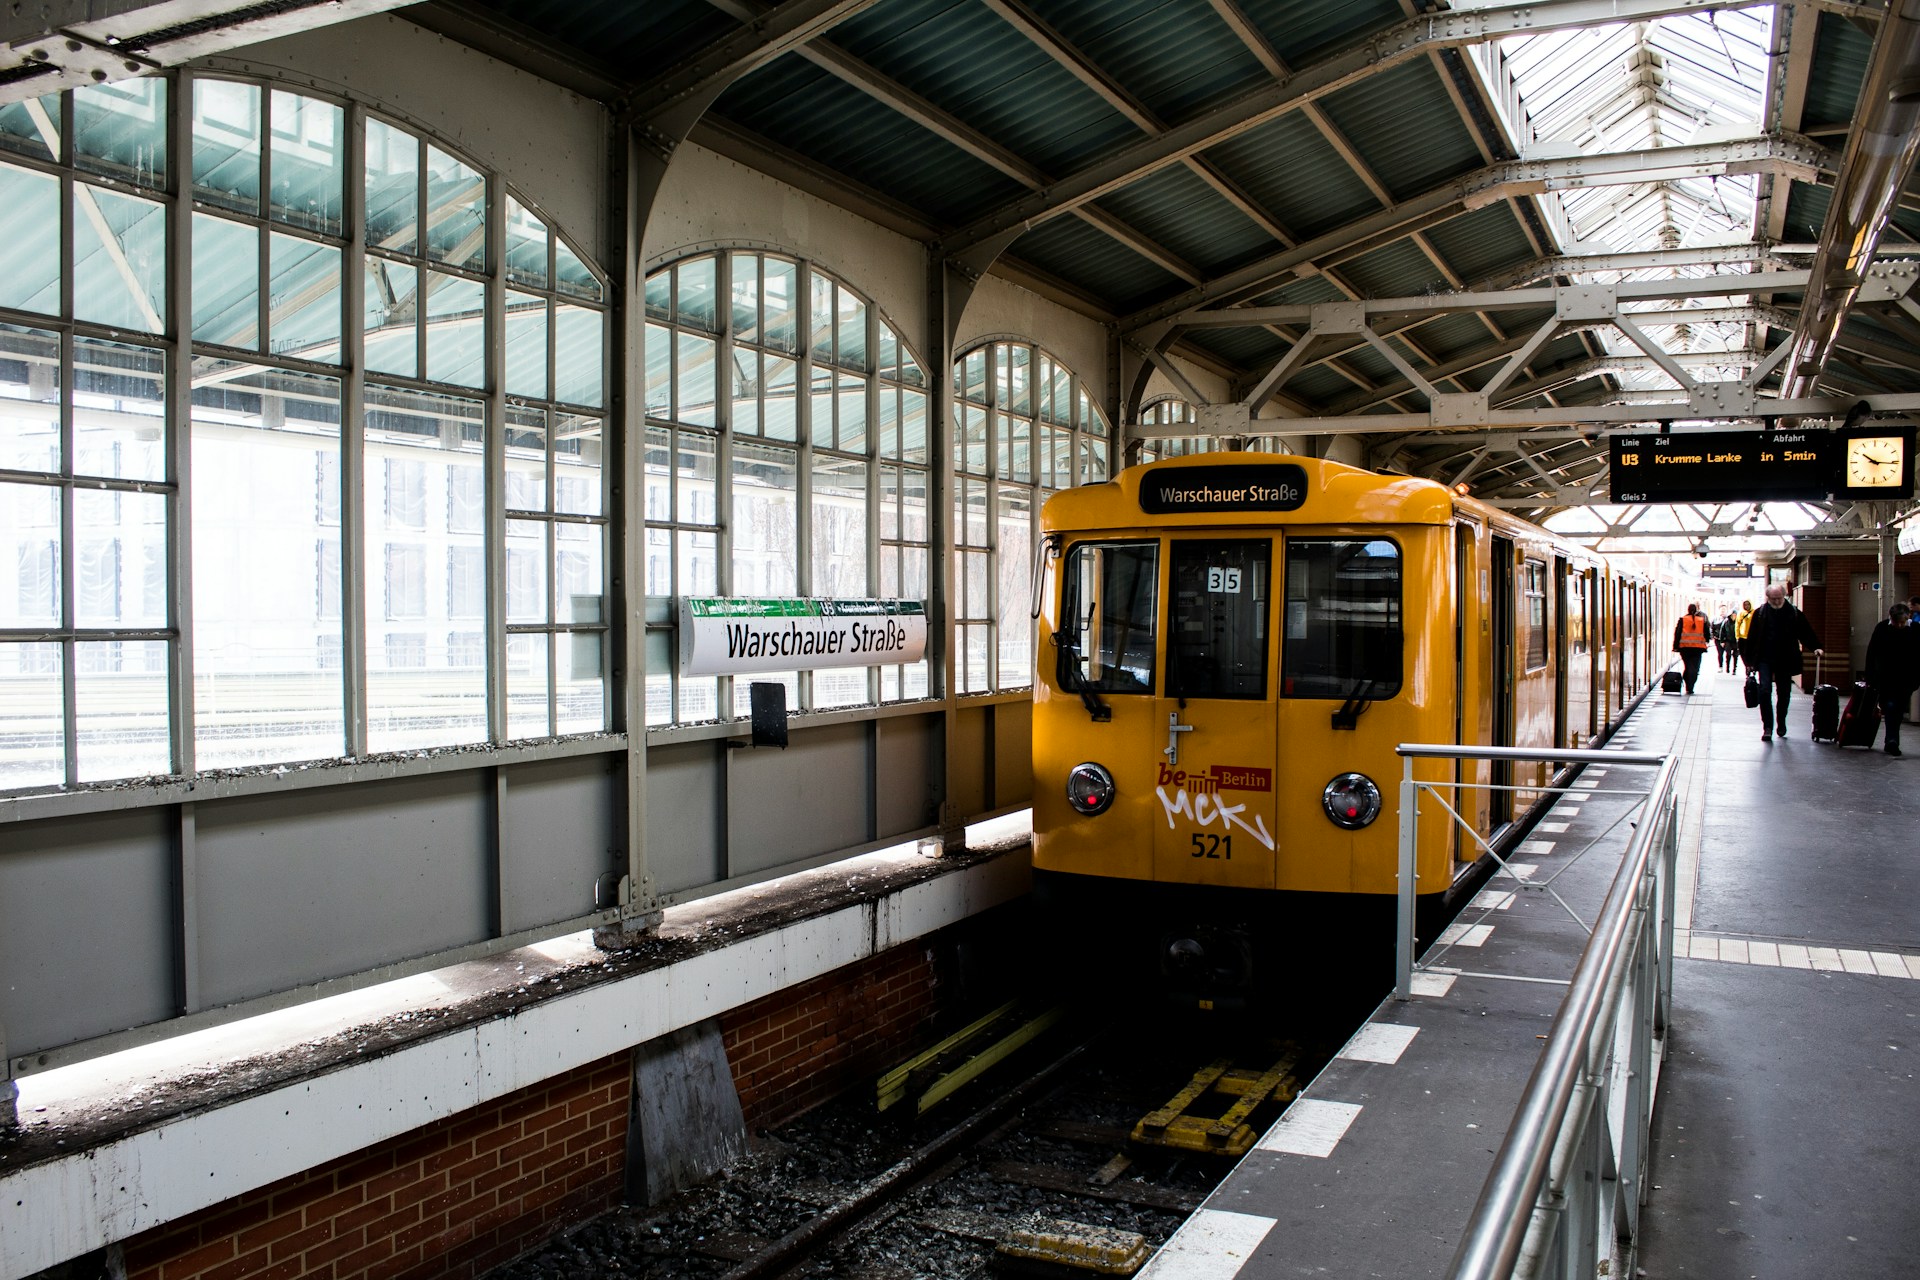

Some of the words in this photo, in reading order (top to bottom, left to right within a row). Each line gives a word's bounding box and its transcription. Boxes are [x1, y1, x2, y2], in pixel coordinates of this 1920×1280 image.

[1621, 438, 1640, 447] Linie
[1655, 437, 1670, 446] Ziel
[1773, 434, 1805, 443] Abfahrt
[1621, 453, 1639, 466] U3
[1655, 454, 1702, 464] Krumme
[1707, 452, 1742, 463] Lanke
[1760, 451, 1774, 462] in
[1783, 450, 1817, 461] 5min
[1160, 486, 1247, 503] Warschauer
[1249, 483, 1298, 502] Straße
[1621, 493, 1640, 501] Gleis
[1641, 493, 1647, 501] 2
[726, 621, 846, 658] Warschauer
[850, 619, 906, 653] Straße
[1158, 762, 1187, 787] be
[1222, 771, 1266, 788] Berlin
[1191, 833, 1232, 860] 521
